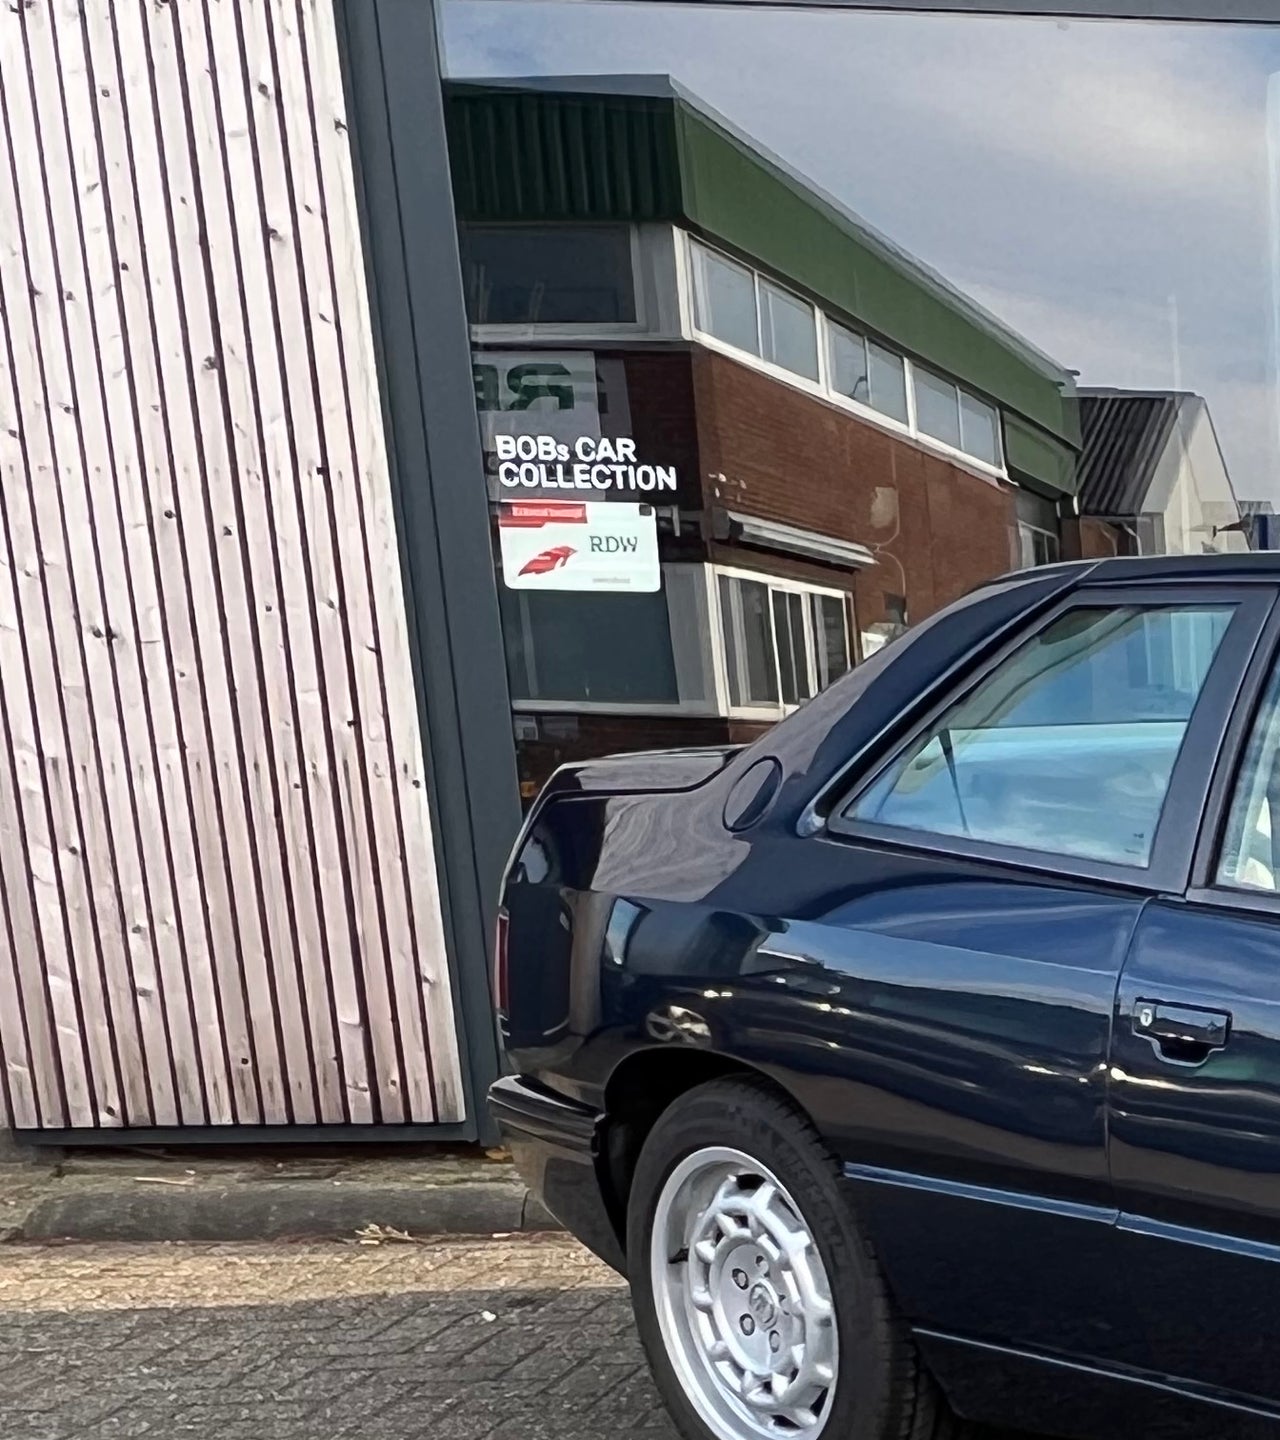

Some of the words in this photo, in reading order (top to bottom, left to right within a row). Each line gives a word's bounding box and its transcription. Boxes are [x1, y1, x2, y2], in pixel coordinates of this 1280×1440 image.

[495, 435, 570, 461] BOBs
[574, 437, 637, 462] CAR
[499, 462, 677, 491] COLLECTION
[589, 535, 638, 553] RDW
